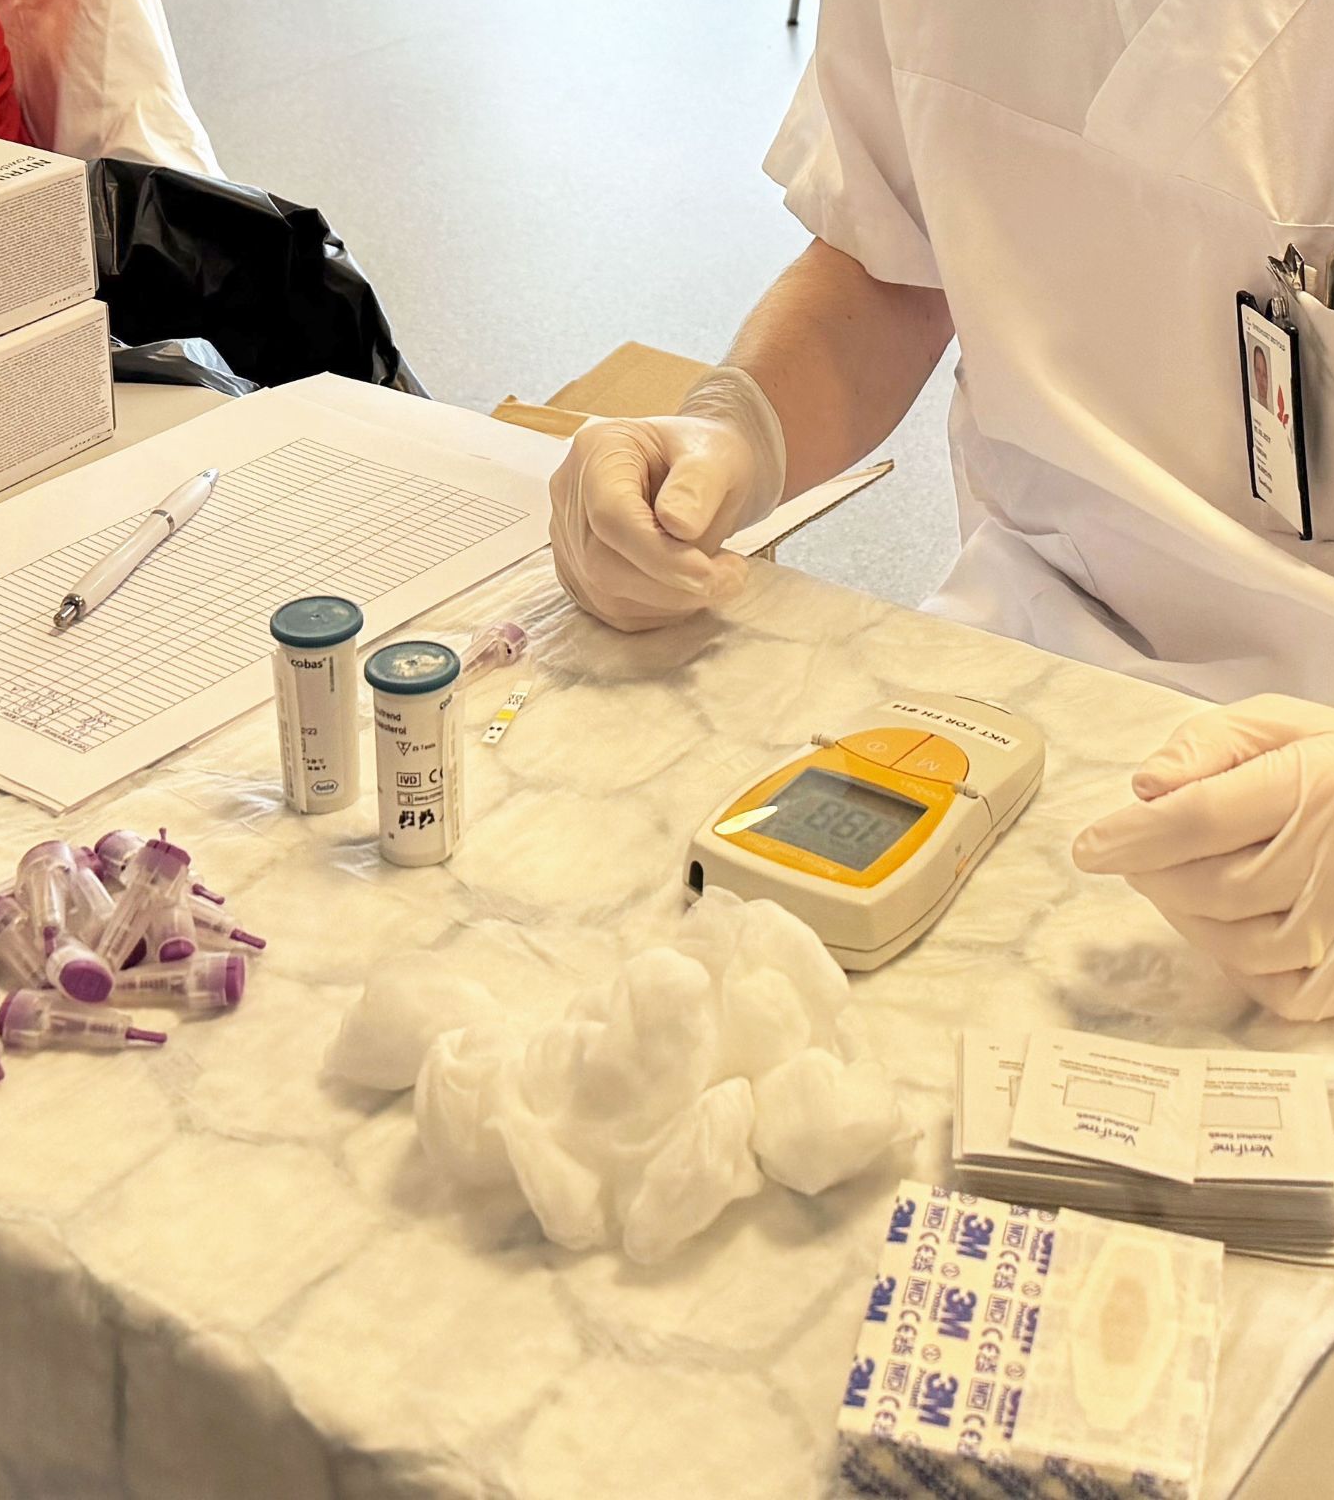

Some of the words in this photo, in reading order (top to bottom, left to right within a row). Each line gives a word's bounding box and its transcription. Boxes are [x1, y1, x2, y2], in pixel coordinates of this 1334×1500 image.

[291, 657, 322, 669] cobas
[921, 710, 943, 720] FH
[946, 717, 975, 731] FOR
[981, 730, 1011, 745] NKT
[400, 775, 417, 785] IVD
[886, 1197, 916, 1244] 3M
[956, 1214, 994, 1260] 3M
[865, 1274, 897, 1322] 3M
[937, 1288, 977, 1341] 3M
[843, 1355, 875, 1408] 3M
[918, 1372, 958, 1428] 3M
